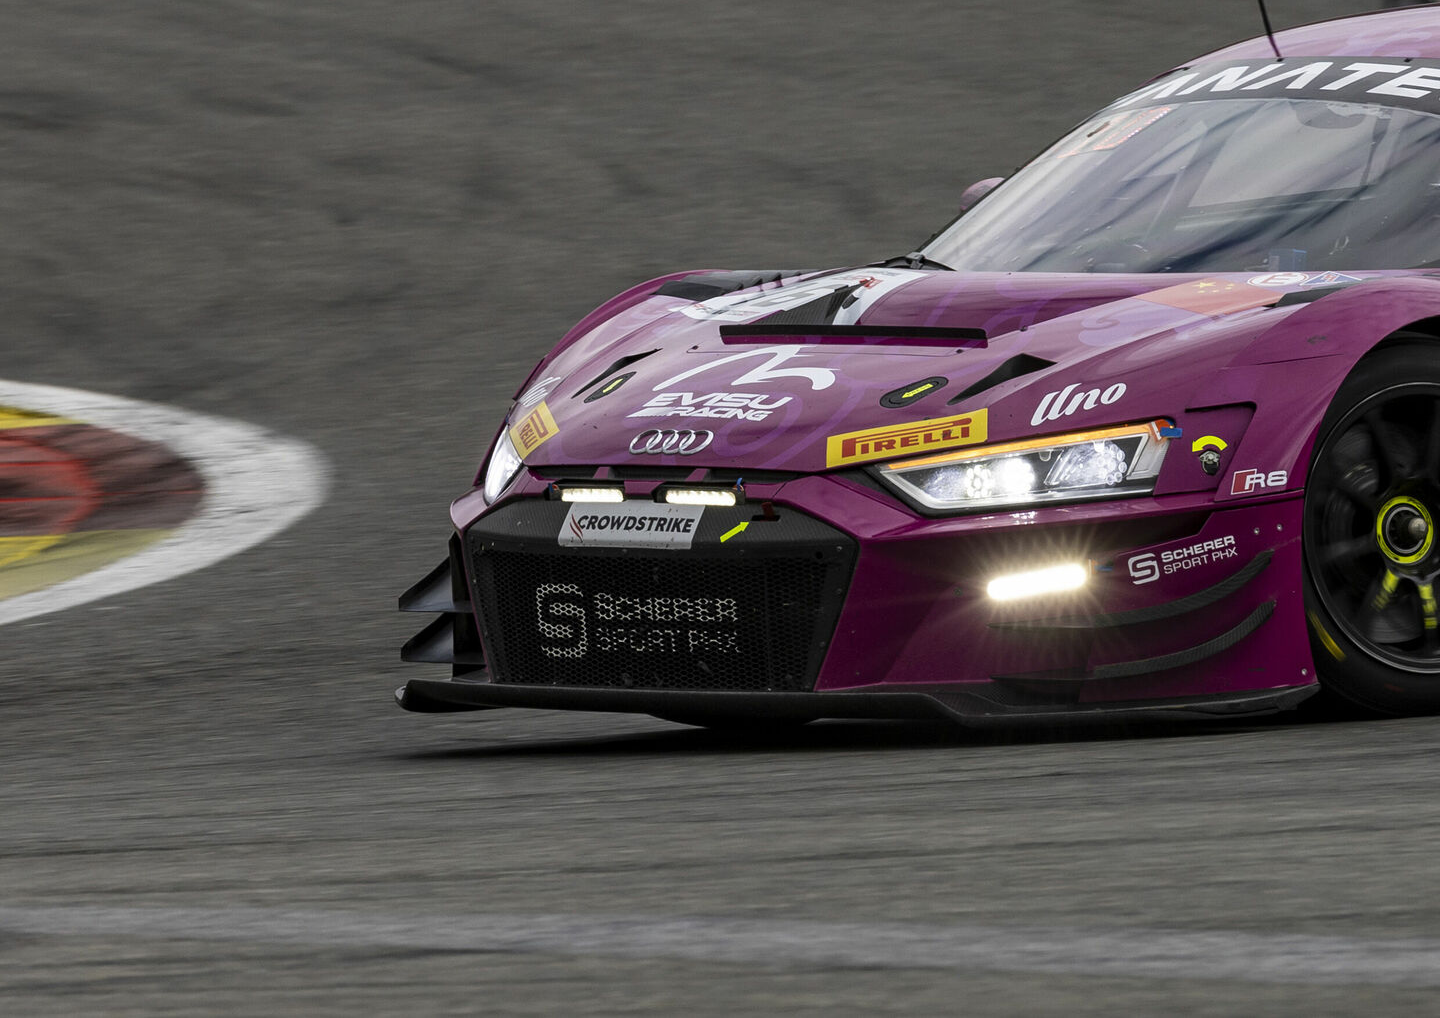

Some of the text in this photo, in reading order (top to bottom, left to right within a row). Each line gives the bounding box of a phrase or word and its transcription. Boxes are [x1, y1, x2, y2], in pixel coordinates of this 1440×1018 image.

[642, 392, 793, 410] EVISU
[668, 407, 774, 422] RACING
[1030, 382, 1127, 426] Uno
[841, 417, 972, 458] PIRELLI
[1244, 470, 1288, 490] R8
[578, 515, 695, 533] CROWDSTRIKE
[1161, 535, 1235, 562] SCHERER
[1163, 547, 1238, 575] SPORT PHX
[593, 592, 738, 622] SCHERER
